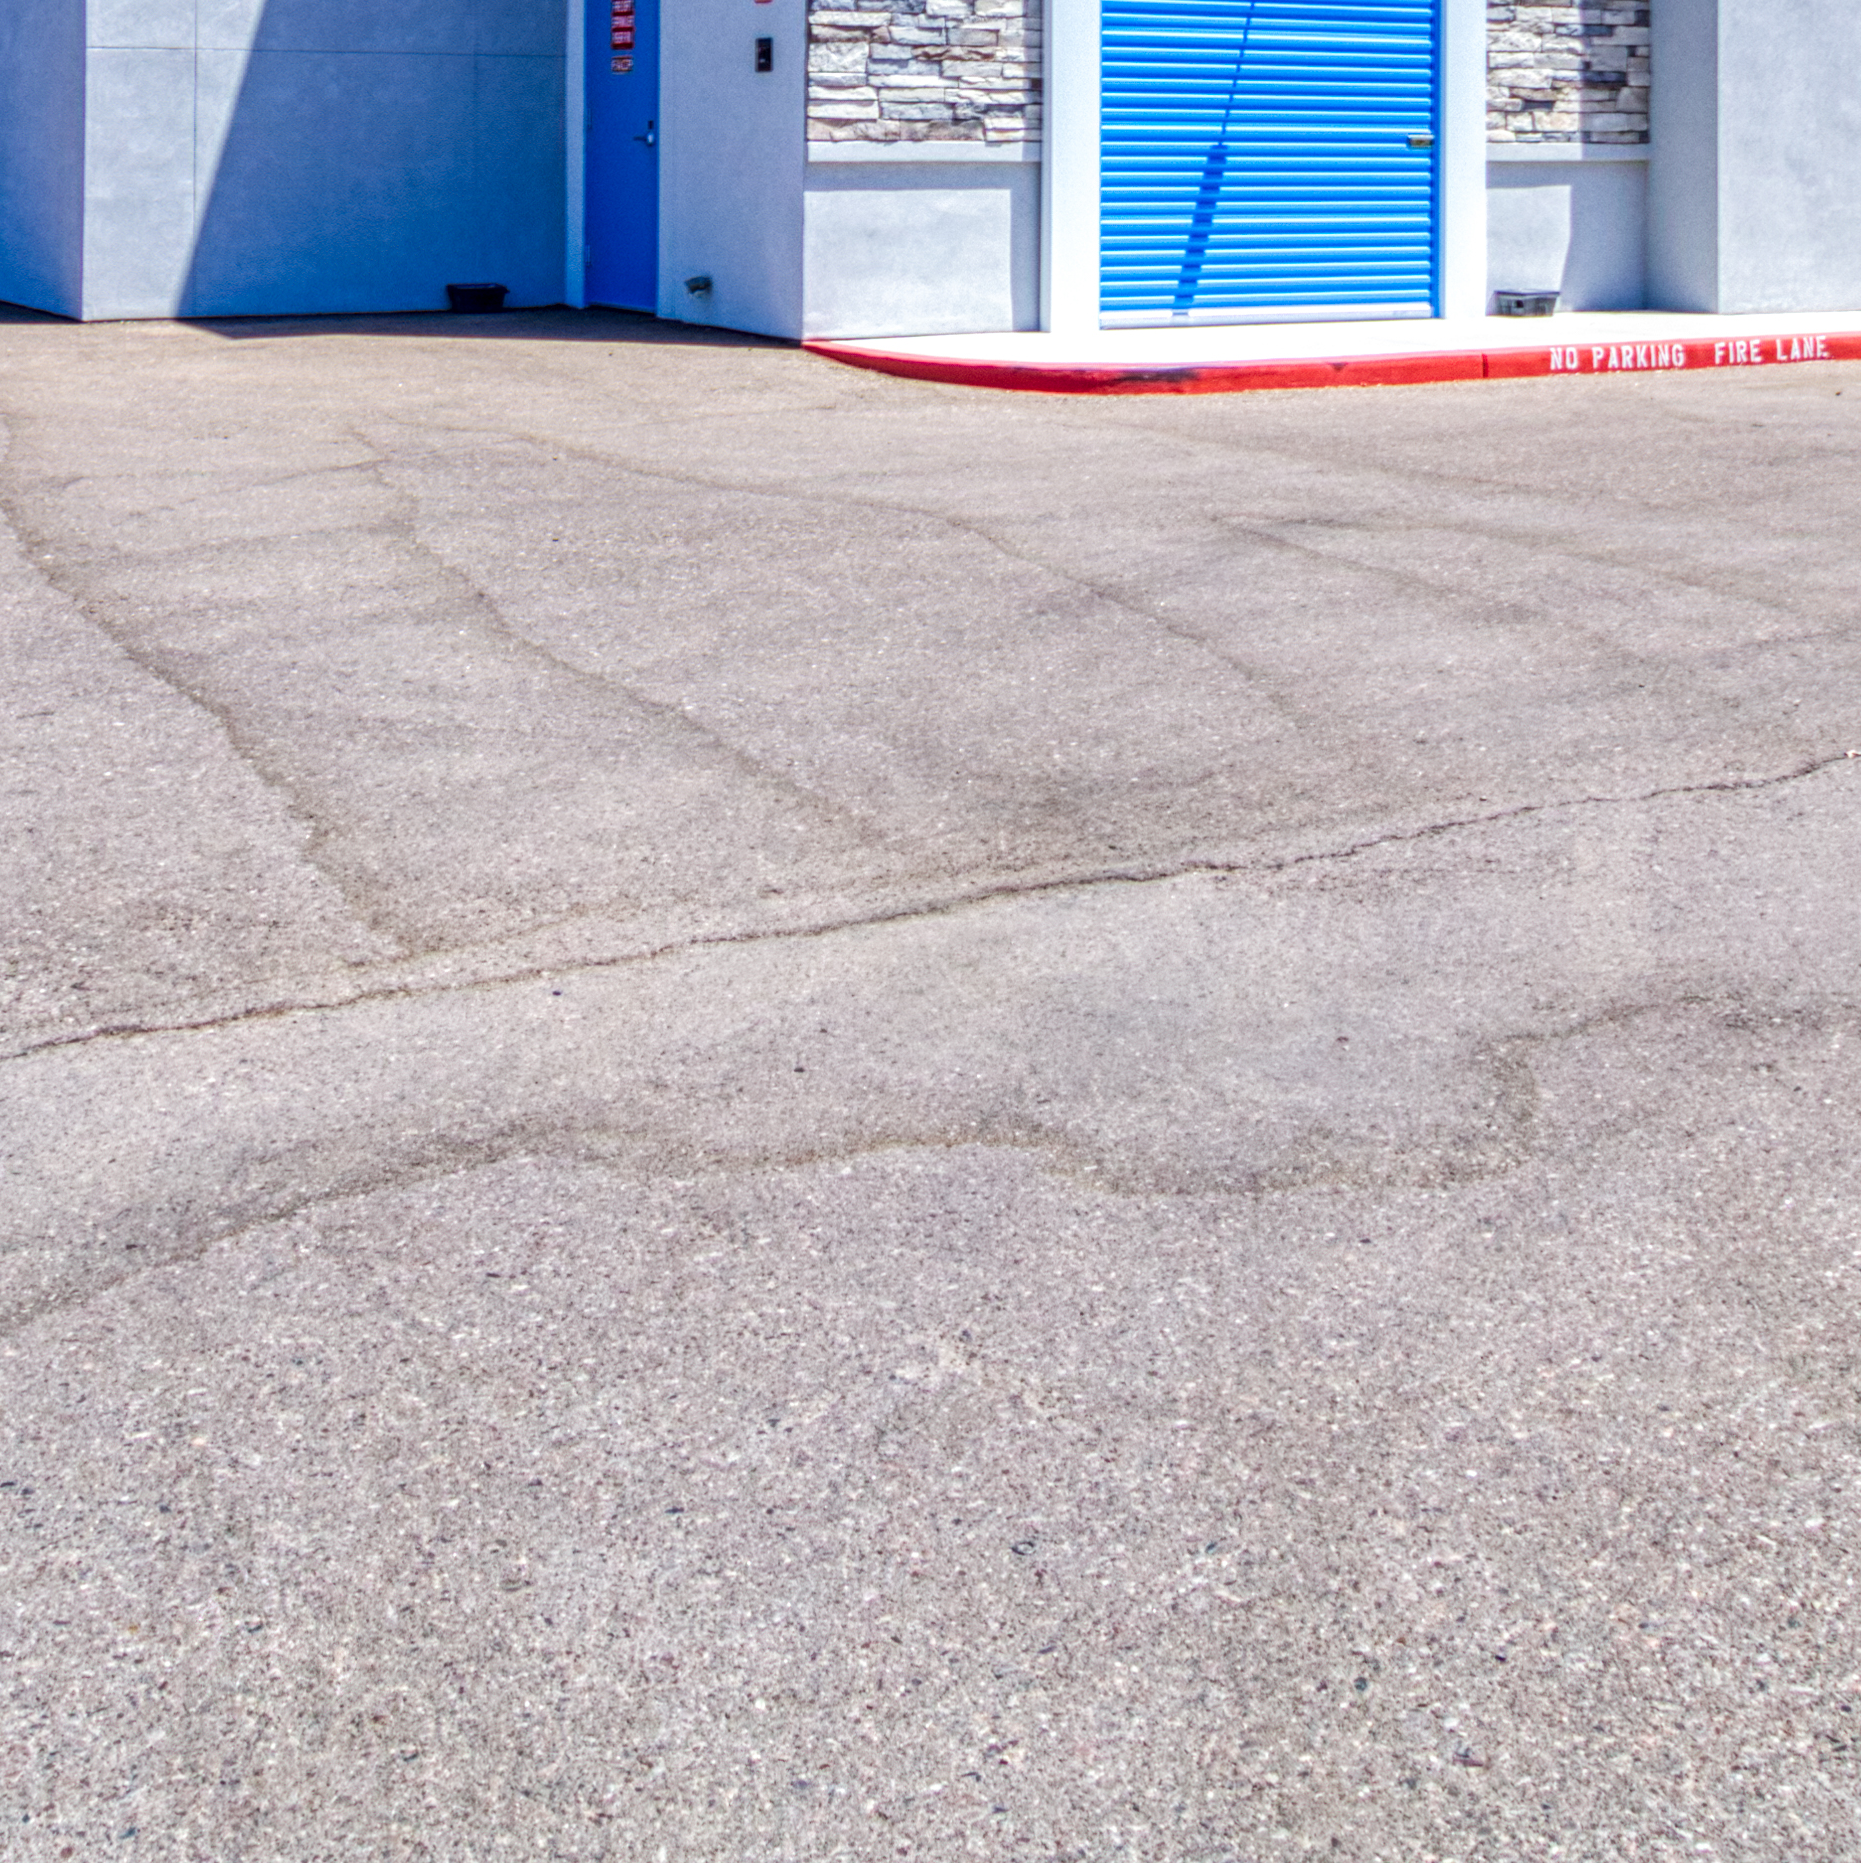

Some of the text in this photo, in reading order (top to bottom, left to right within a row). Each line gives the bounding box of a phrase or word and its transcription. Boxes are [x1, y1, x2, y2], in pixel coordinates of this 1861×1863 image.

[1549, 335, 1830, 370] NO PARKING FIRE LANE
